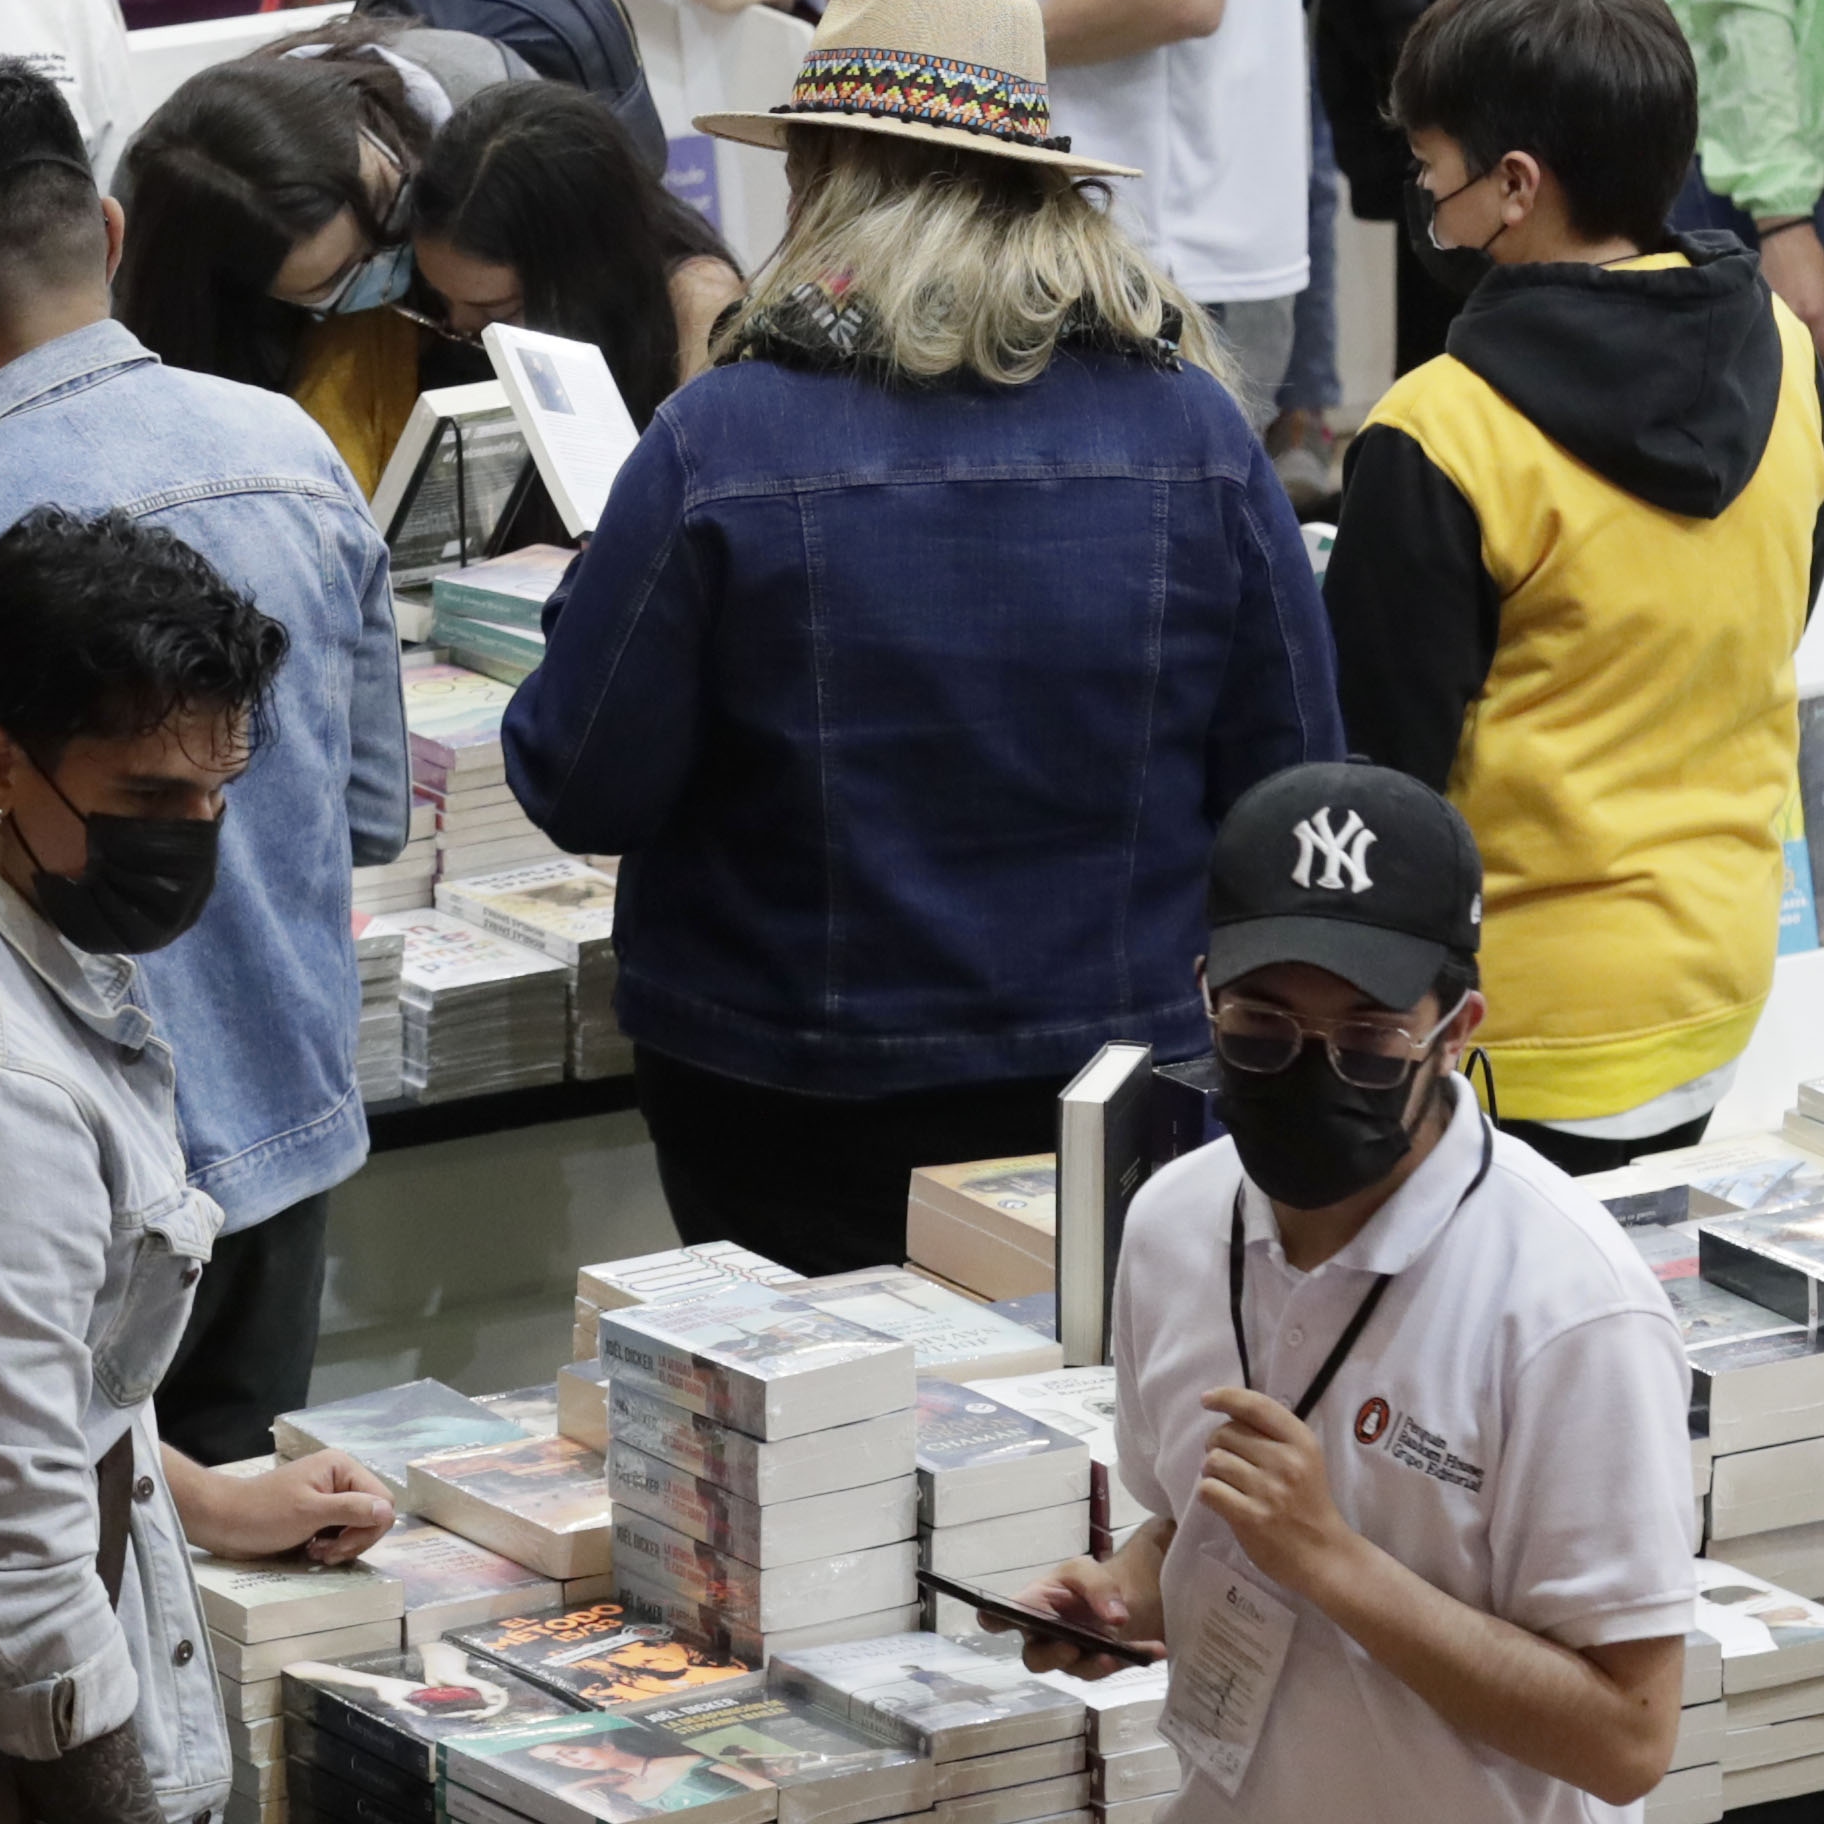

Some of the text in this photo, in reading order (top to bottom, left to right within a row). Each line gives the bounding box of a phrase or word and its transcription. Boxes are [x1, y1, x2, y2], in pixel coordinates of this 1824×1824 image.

[1291, 806, 1378, 894] NY
[624, 1345, 654, 1371] DICKER
[1403, 1416, 1448, 1451] Penguin
[1424, 1460, 1484, 1494] Editorial
[486, 1603, 624, 1651] MÉTODO
[498, 1615, 541, 1630] EL
[552, 1617, 624, 1643] 15/33
[683, 1698, 739, 1716] DICKER
